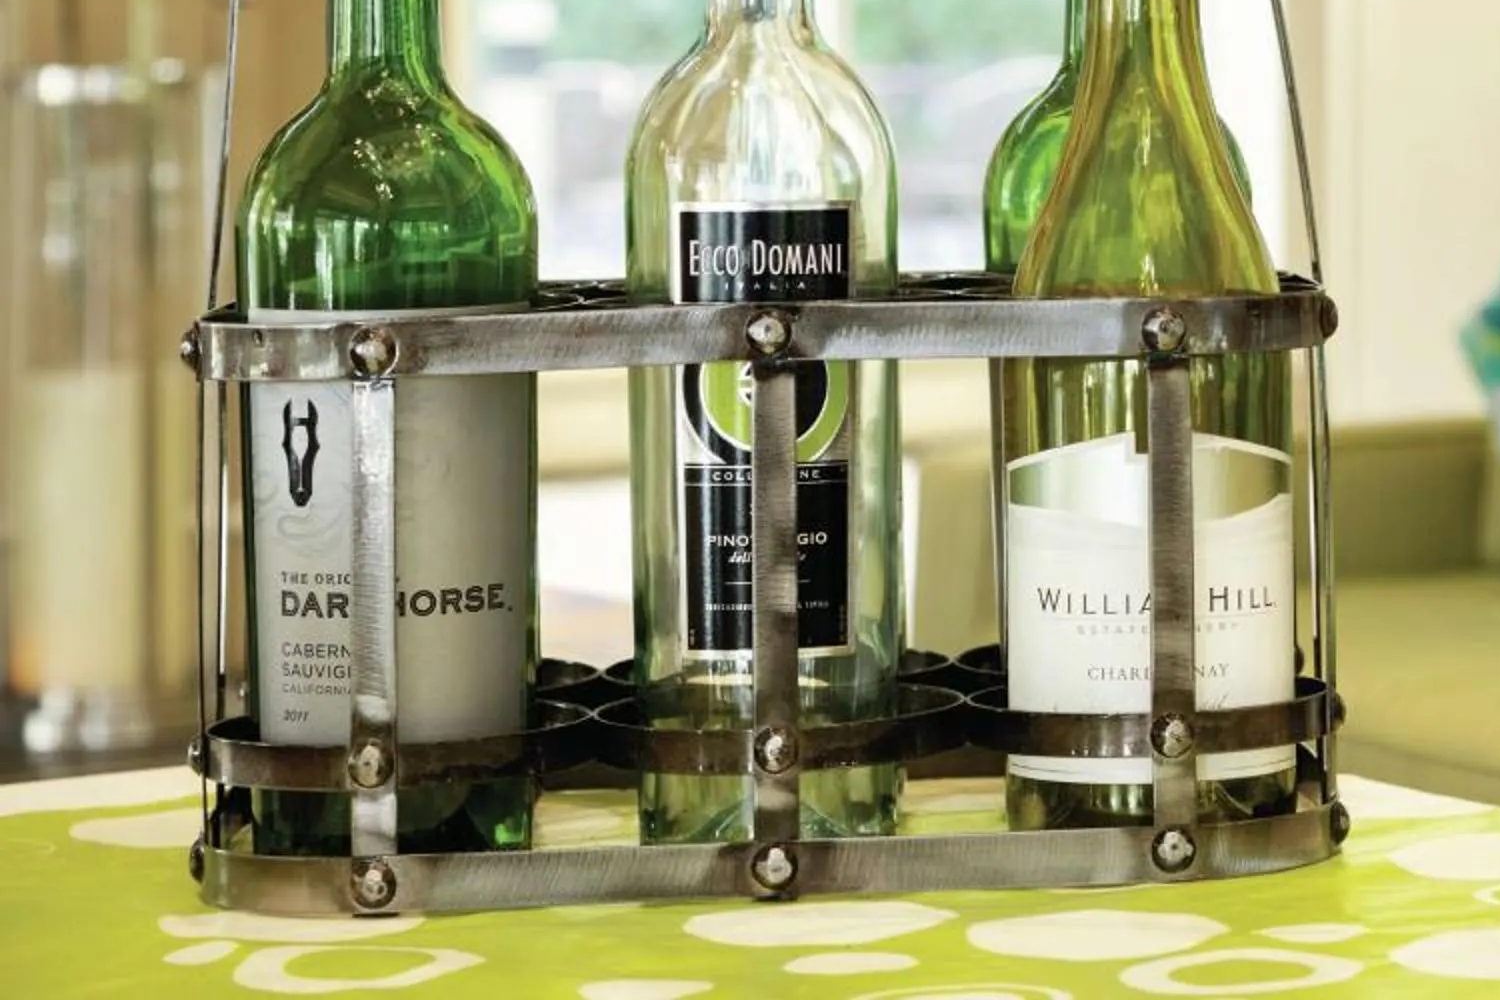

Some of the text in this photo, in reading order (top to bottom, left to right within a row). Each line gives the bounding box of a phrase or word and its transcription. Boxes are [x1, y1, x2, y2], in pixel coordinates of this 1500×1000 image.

[689, 239, 841, 276] ECCO DOMANI
[724, 281, 806, 291] ITALIA
[712, 470, 821, 481] COLLNE
[706, 531, 828, 547] PINO GIO
[281, 571, 309, 585] THE
[281, 590, 350, 619] DAR
[1037, 586, 1273, 615] WILLIA HILL
[281, 642, 352, 659] CABERN
[281, 662, 352, 679] SAUVIG
[1087, 663, 1230, 681] CHARNAY
